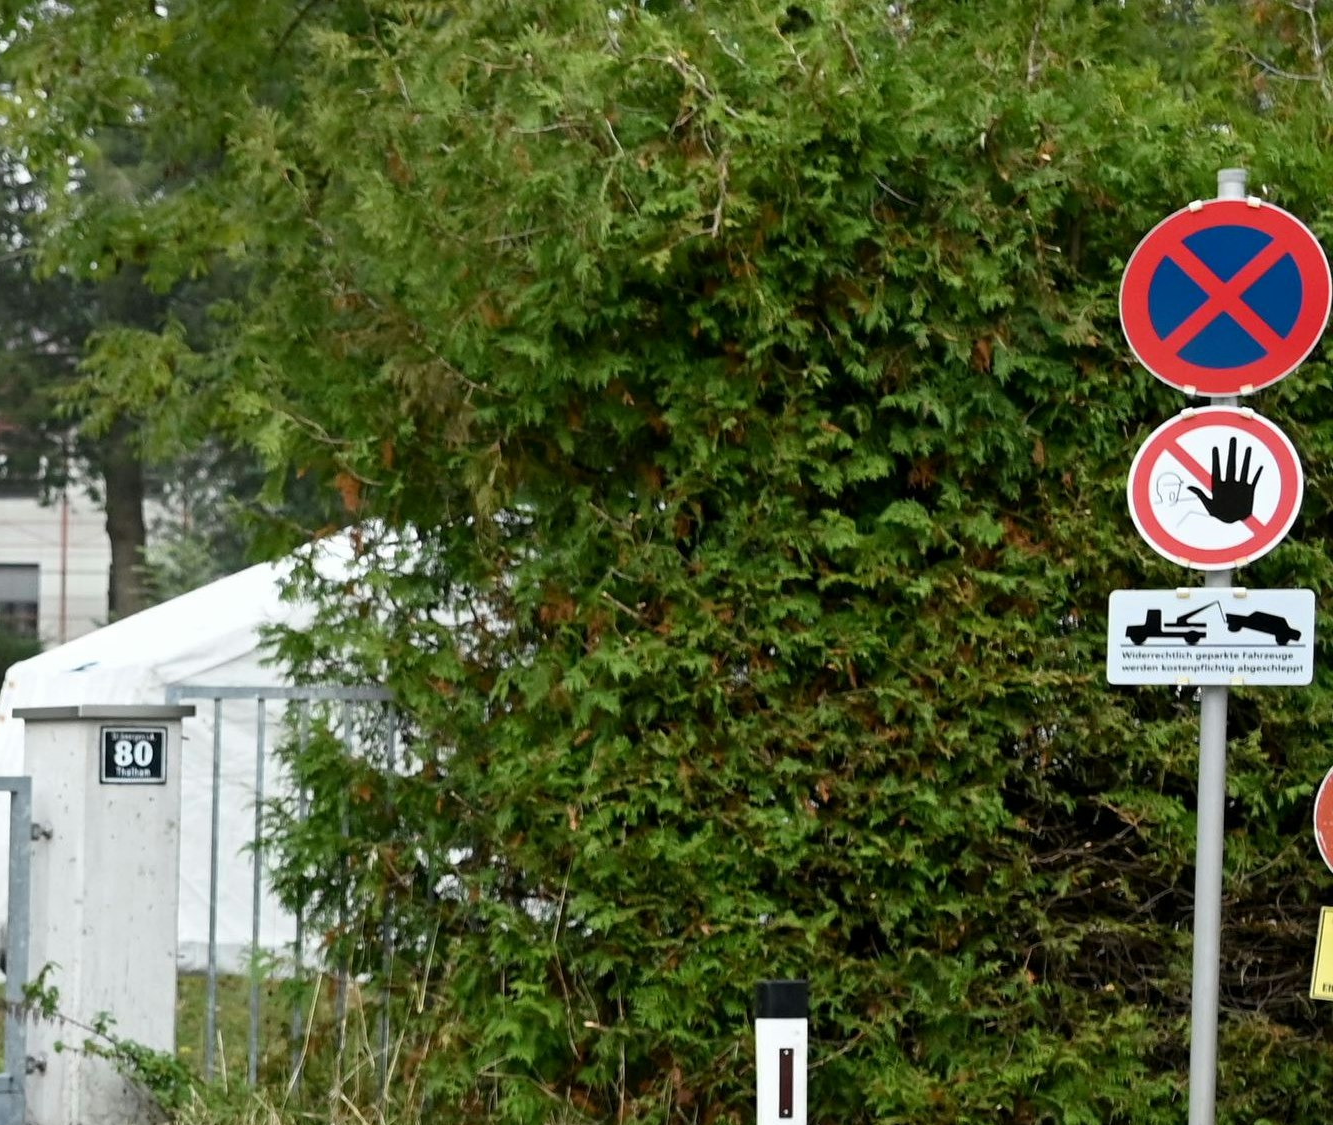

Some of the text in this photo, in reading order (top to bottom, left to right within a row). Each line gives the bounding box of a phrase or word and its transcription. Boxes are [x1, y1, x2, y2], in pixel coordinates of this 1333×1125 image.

[1122, 651, 1294, 661] Widerrechtlich geparkte Fahrzeuge
[1121, 664, 1303, 674] werden kostenpflichtig abgeschleppt
[114, 740, 153, 767] 80
